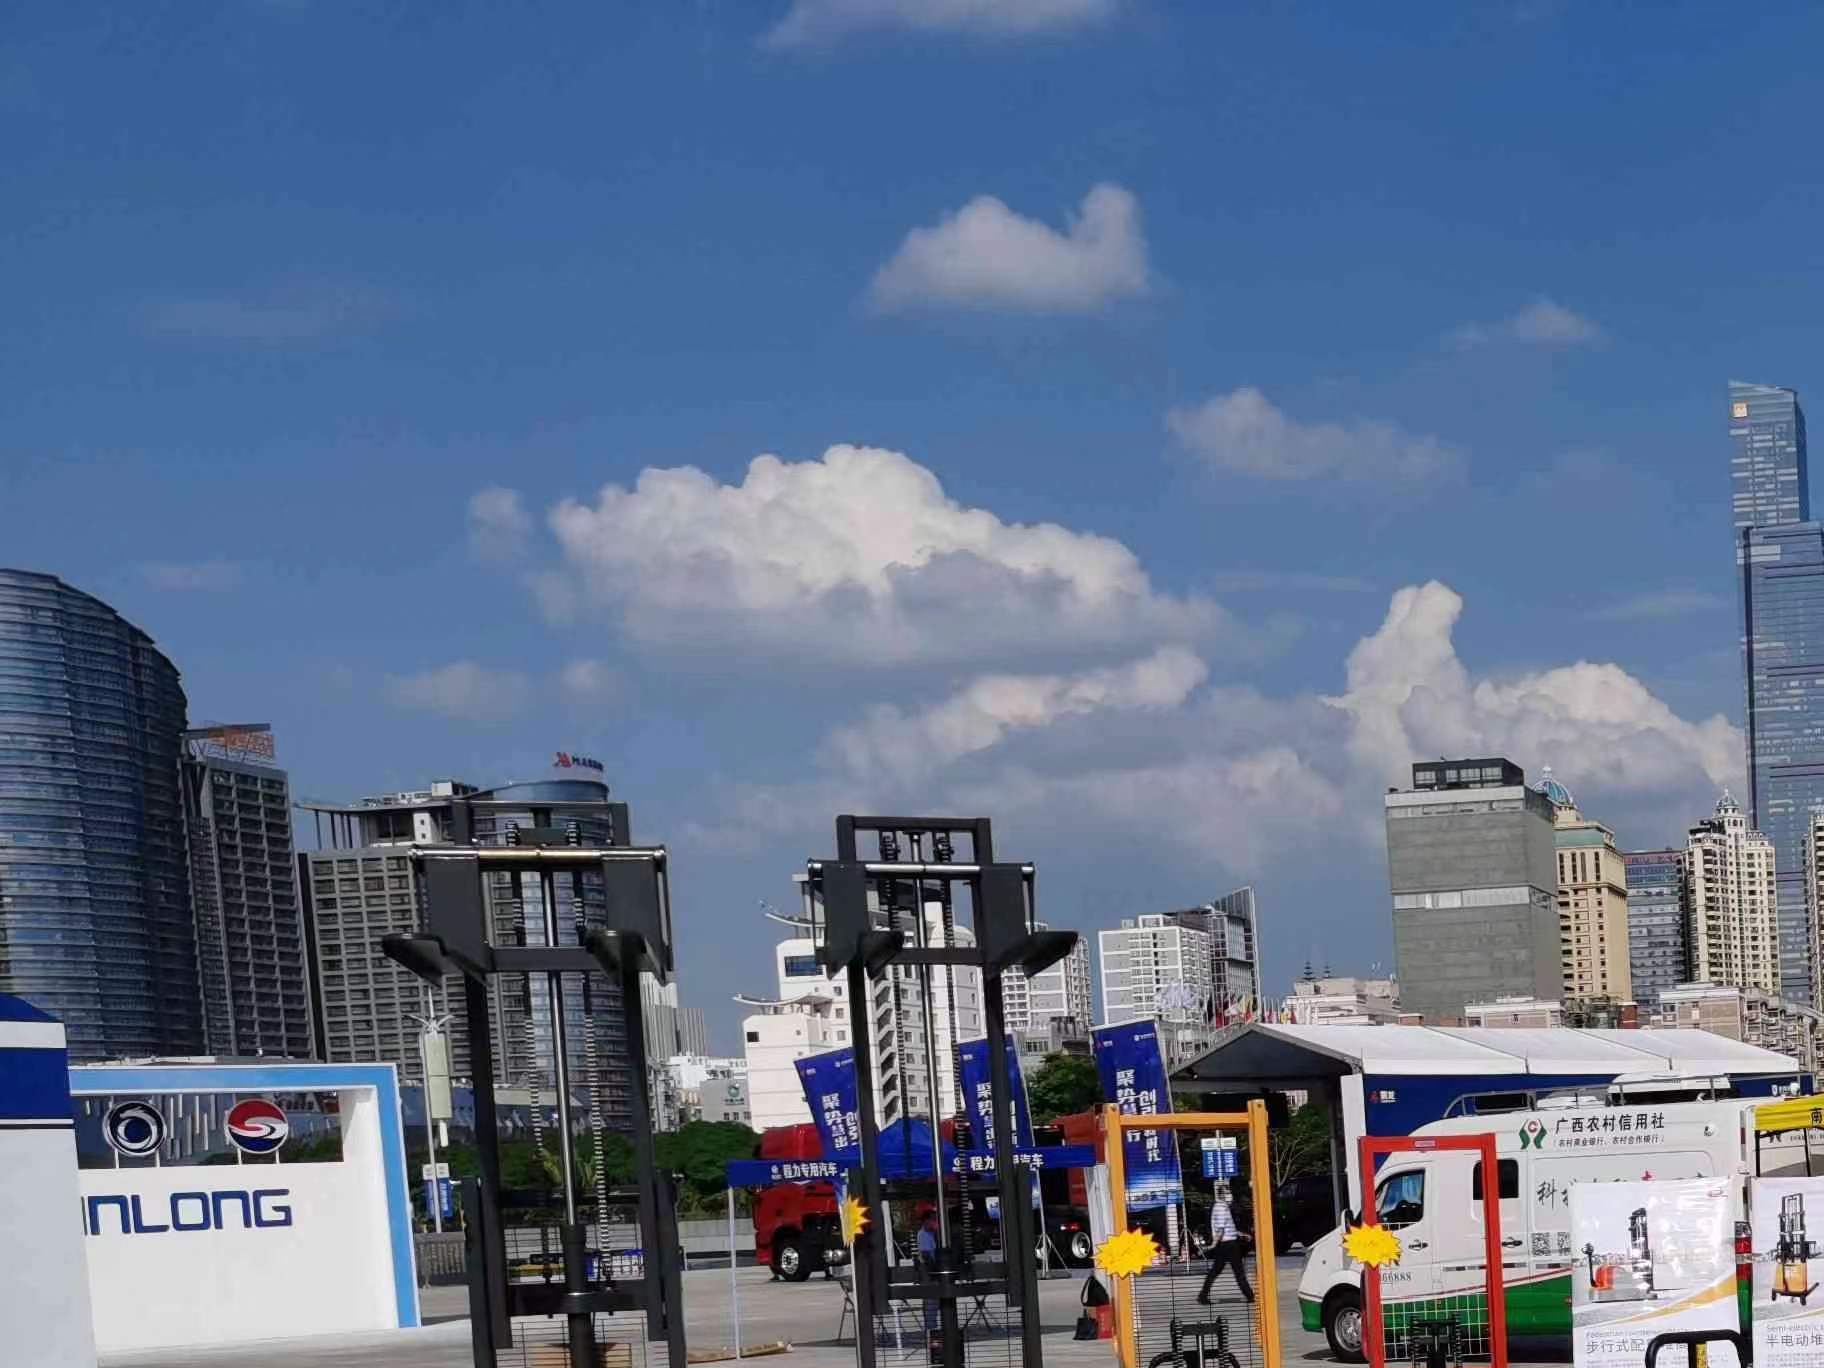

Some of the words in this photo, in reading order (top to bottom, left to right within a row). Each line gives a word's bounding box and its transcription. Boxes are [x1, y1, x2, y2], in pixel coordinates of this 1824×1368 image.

[1555, 1112, 1665, 1134] 广西农村信用社
